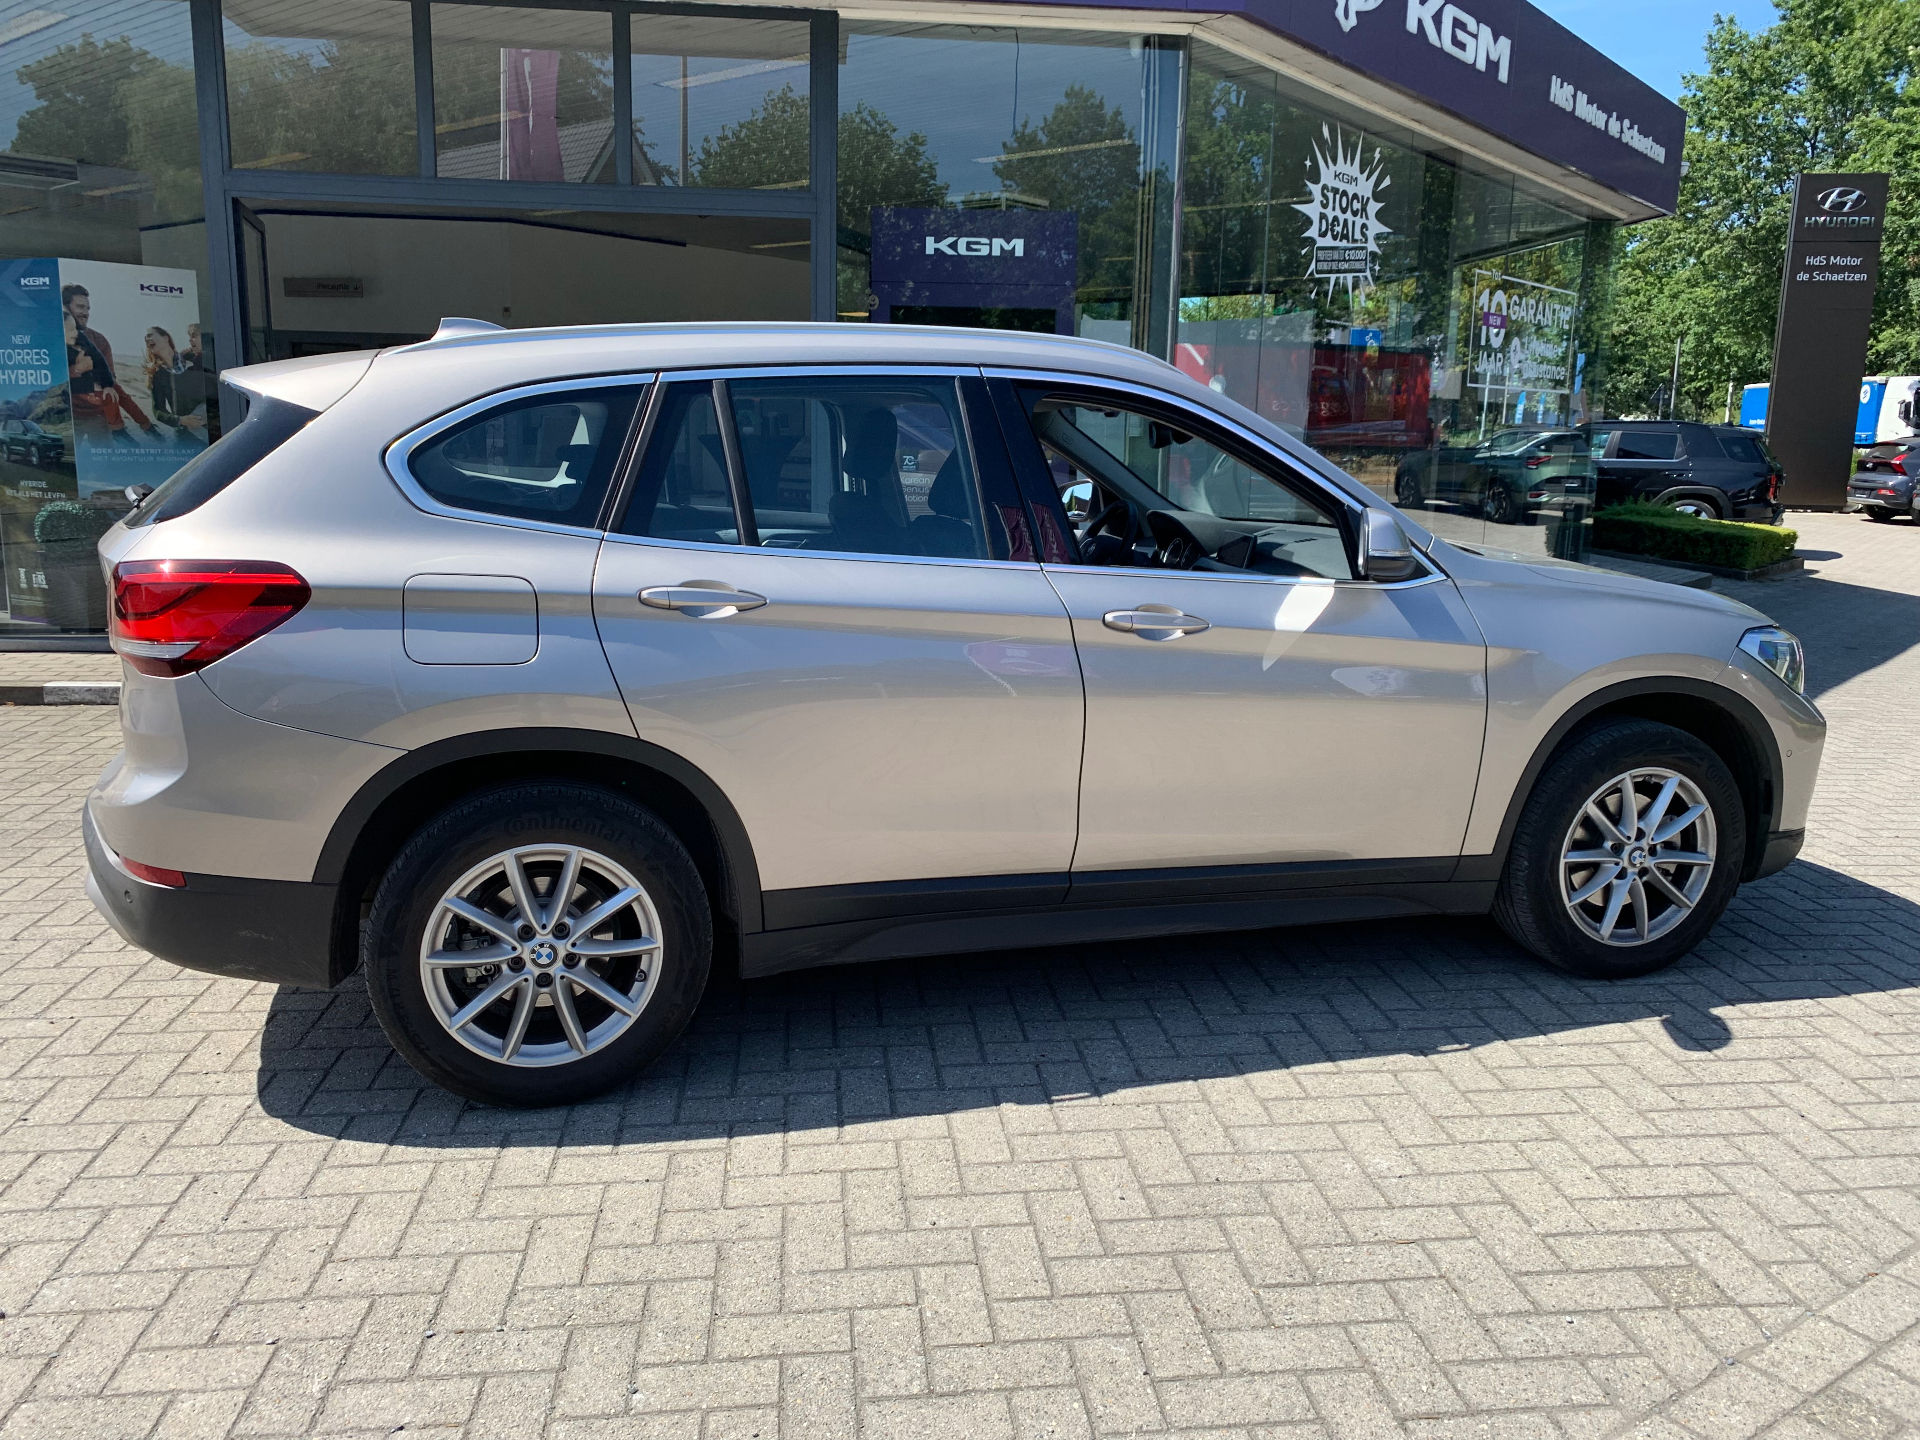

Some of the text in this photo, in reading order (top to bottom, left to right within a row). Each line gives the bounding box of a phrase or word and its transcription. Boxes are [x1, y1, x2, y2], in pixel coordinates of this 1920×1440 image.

[1406, 0, 1511, 84] KGM
[1550, 75, 1665, 164] HdS Motor de Schaetzen
[1334, 170, 1358, 186] KGM
[1320, 184, 1370, 220] STOCK
[1804, 216, 1875, 228] HYUNDAI
[925, 236, 1025, 257] KGM
[1805, 255, 1863, 266] HdS Motor
[20, 277, 50, 286] KGM
[1796, 271, 1868, 282] de Schaetzen
[140, 283, 184, 295] KGM
[1479, 288, 1508, 349] 10
[1488, 315, 1502, 326] NEW
[1509, 295, 1572, 330] GARANTIE
[11, 335, 31, 344] NEW
[1474, 350, 1503, 376] JAAR
[0, 369, 52, 386] HYBRID
[503, 815, 624, 845] Continental
